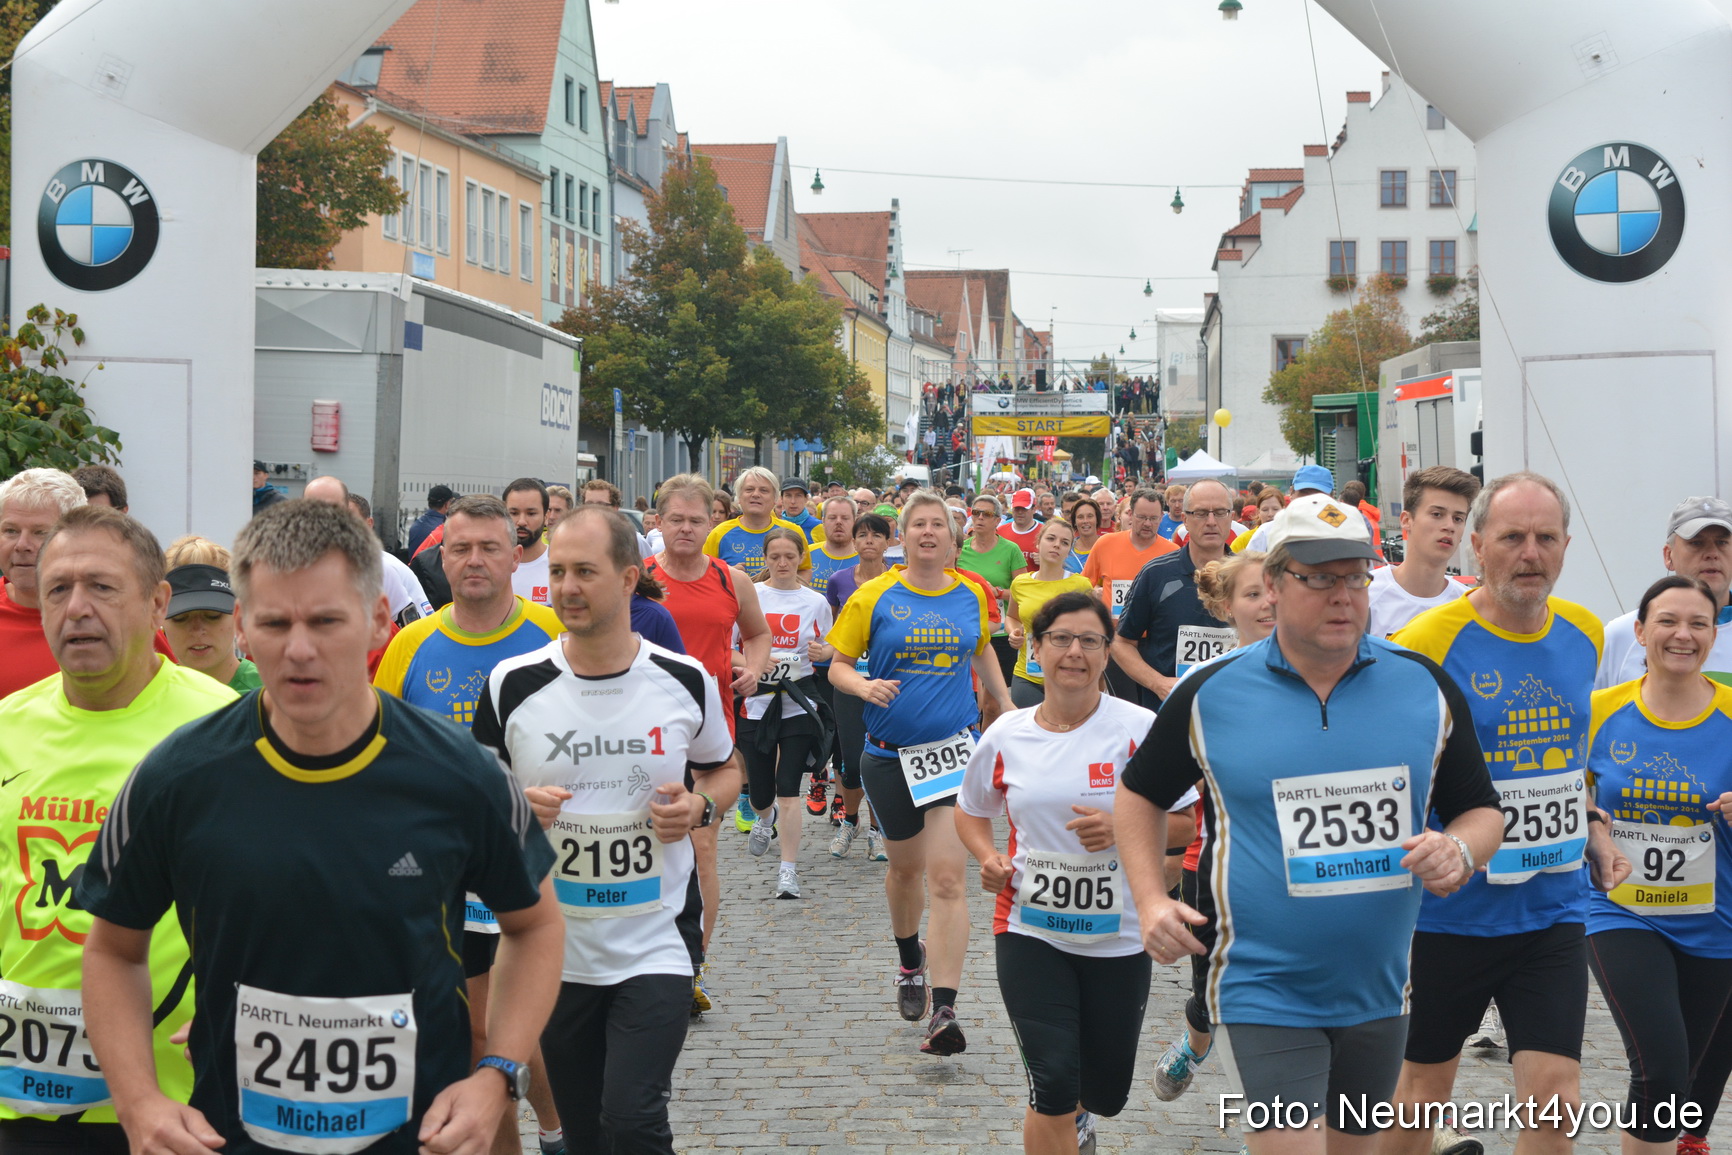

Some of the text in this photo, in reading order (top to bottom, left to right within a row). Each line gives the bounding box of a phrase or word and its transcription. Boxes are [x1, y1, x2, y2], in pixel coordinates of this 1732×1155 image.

[1559, 145, 1676, 193] BMW
[45, 161, 150, 206] BMW
[541, 382, 572, 431] BOCK
[1017, 420, 1064, 432] START
[772, 635, 796, 646] KMS
[1180, 630, 1202, 638] PARTL
[1183, 641, 1232, 662] 203
[431, 677, 447, 685] Jahre
[1478, 680, 1497, 689] Jahre
[1497, 734, 1570, 749] 21.September 2014
[910, 741, 971, 781] 3395
[1091, 778, 1113, 786] DKMS
[1277, 781, 1387, 803] PARTL Neumarkt
[1502, 783, 1572, 801] RTL Neumarkt
[18, 795, 109, 825] Mülle
[1623, 801, 1679, 812] 21.September
[553, 819, 643, 835] PARTL Neumarkt
[1293, 797, 1400, 850] 2533
[1502, 797, 1579, 843] 2535
[1613, 829, 1648, 842] PARTL
[561, 835, 653, 878] 2193
[1026, 857, 1105, 873] PARTL Neumarkt
[1316, 855, 1391, 879] Bernhard
[1522, 848, 1563, 868] Hubert
[1643, 847, 1686, 882] 92
[388, 866, 423, 876] adidas
[586, 888, 628, 903] Peter
[1030, 873, 1114, 910] 2905
[1635, 888, 1689, 903] Daniela
[1046, 915, 1093, 933] Sibylle
[0, 993, 83, 1017] RTL Neumar
[240, 1003, 384, 1030] PARTL Neumarkt
[253, 1031, 397, 1094] 2495
[23, 1075, 74, 1100] Peter
[276, 1105, 366, 1132] Michael
